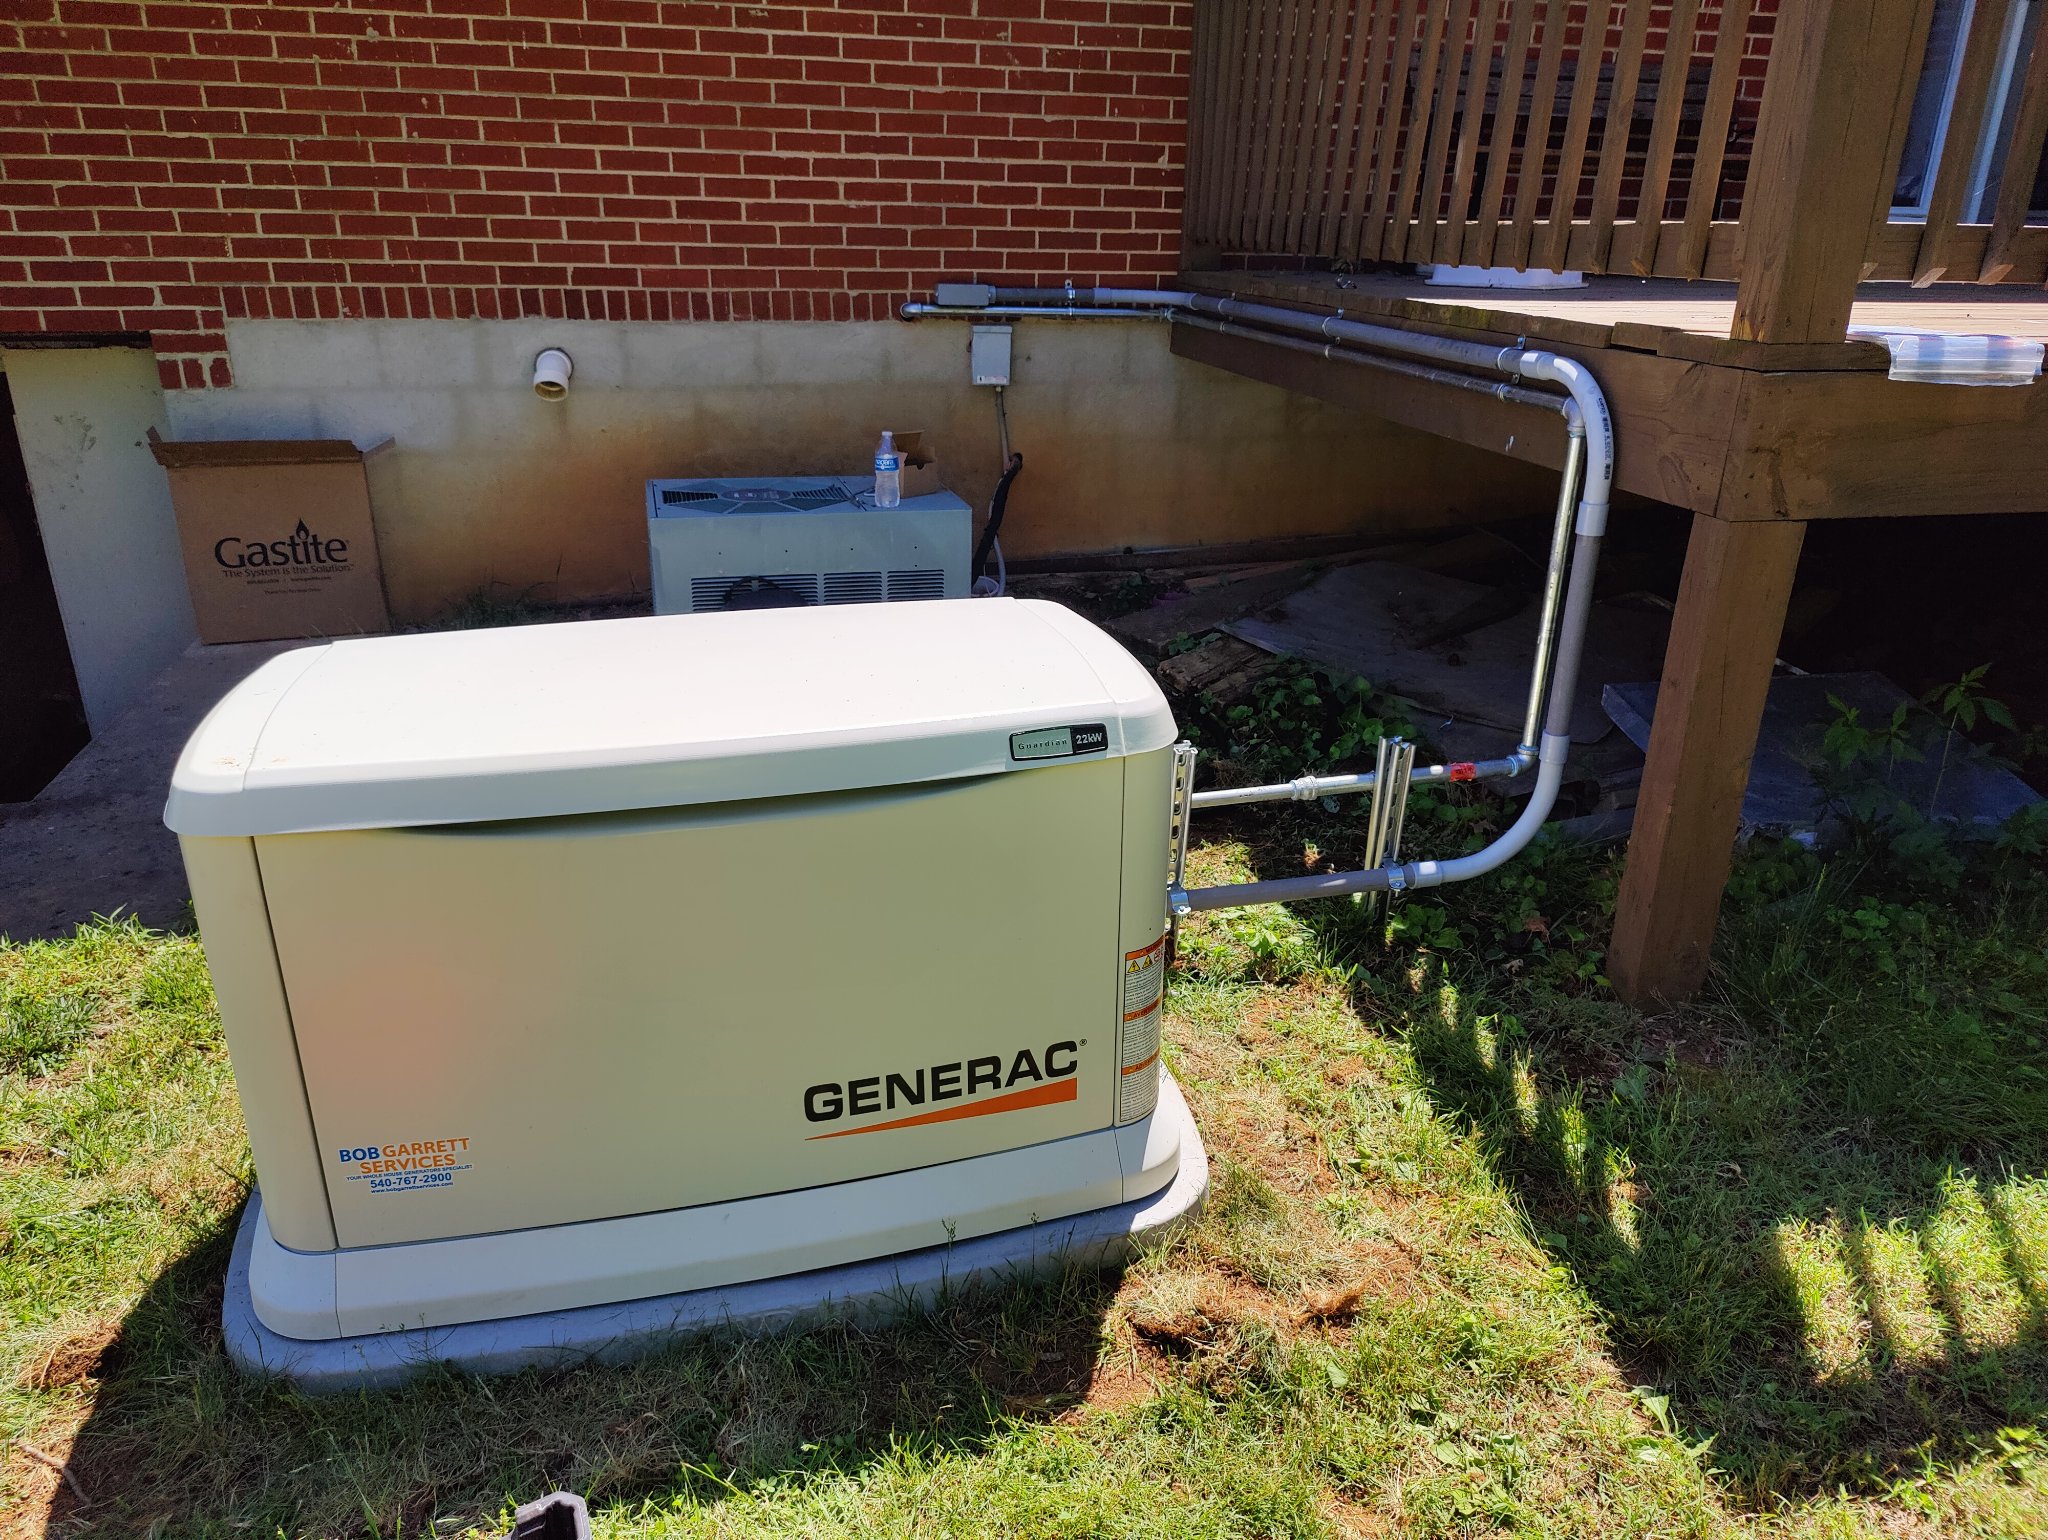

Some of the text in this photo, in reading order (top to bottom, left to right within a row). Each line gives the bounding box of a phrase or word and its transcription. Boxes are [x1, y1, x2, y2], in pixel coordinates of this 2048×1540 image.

[223, 568, 242, 579] The
[244, 567, 280, 578] System
[282, 566, 291, 575] is
[292, 564, 309, 575] the
[1018, 733, 1102, 750] Guardian 22kW
[339, 1137, 469, 1162] BOB GARRETT
[360, 1154, 456, 1174] SERVICES
[370, 1172, 452, 1188] 540-767-2900
